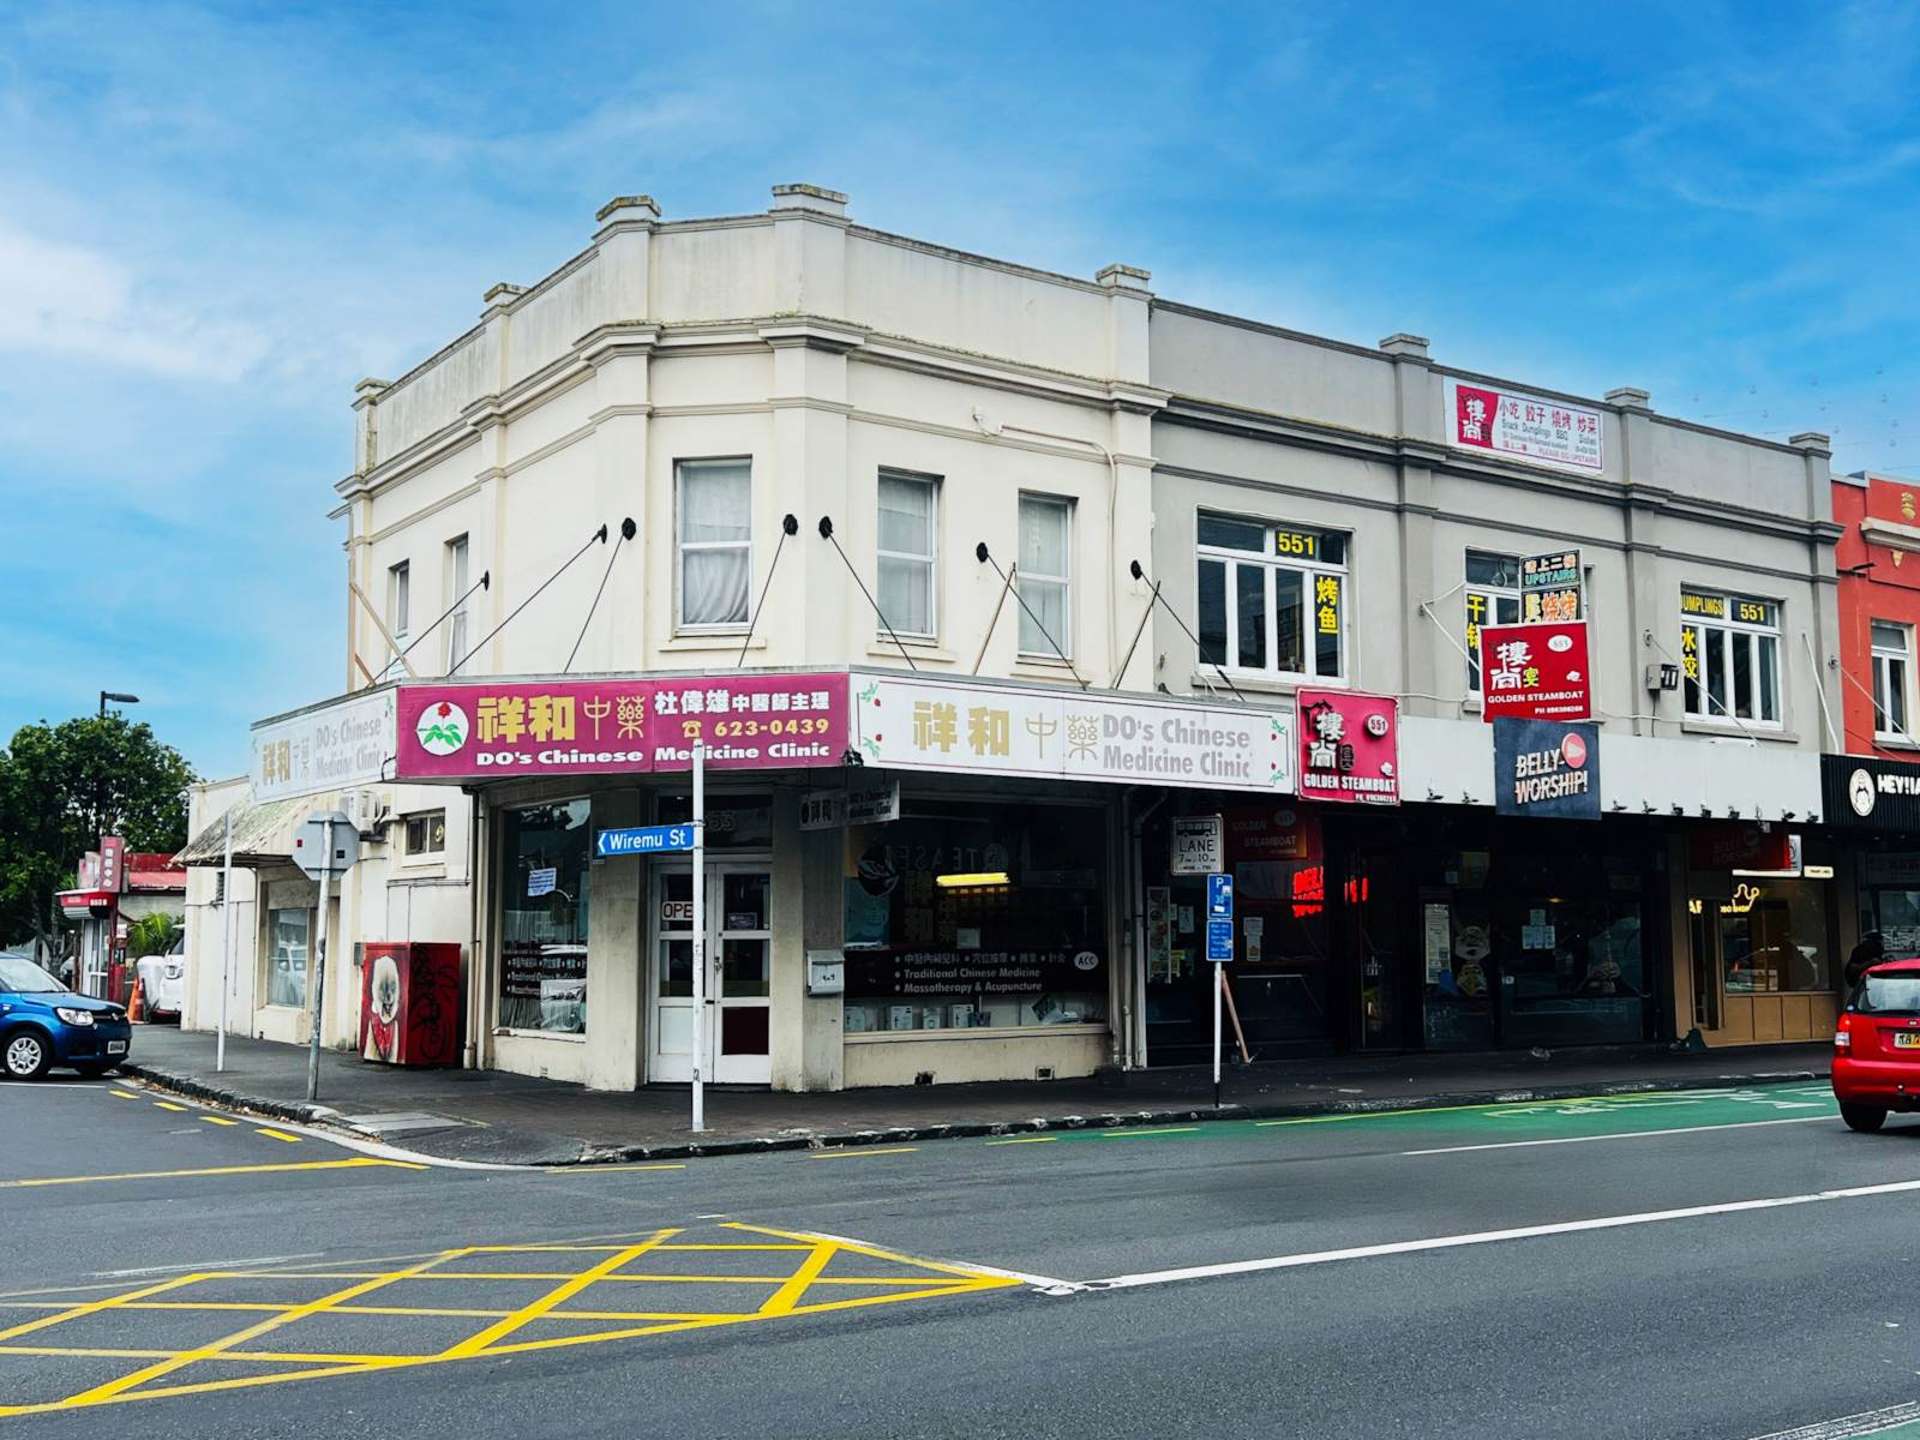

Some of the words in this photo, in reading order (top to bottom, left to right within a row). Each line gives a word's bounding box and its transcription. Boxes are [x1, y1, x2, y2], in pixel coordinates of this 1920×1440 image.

[1278, 533, 1314, 556] 551
[1740, 603, 1764, 621] 551
[1488, 694, 1526, 704] GOLDEN
[1527, 690, 1585, 702] STEAMBOAT
[340, 715, 382, 741] Chinese
[714, 718, 829, 737] 623-0439
[1103, 714, 1155, 741] DO's
[1161, 718, 1250, 748] Chinese
[1370, 718, 1386, 731] 551
[356, 743, 382, 770] Clinic
[477, 751, 533, 766] DO's
[538, 749, 644, 764] Chinese
[655, 744, 760, 761] Meicine
[768, 742, 830, 758] Clinic
[1103, 745, 1194, 774] Medicine
[1200, 751, 1250, 778] Clinic
[1303, 773, 1339, 789] GOLDEN
[1341, 776, 1396, 792] STEAMBOAT
[1515, 770, 1589, 804] WORSHIP!
[610, 833, 663, 851] Wiremu
[669, 829, 686, 846] St
[1179, 839, 1214, 852] LANE
[1216, 877, 1224, 888] P
[664, 903, 694, 918] OPE
[904, 968, 958, 980] Traditional
[960, 967, 997, 979] Chinese
[999, 966, 1041, 978] Medicine
[904, 983, 973, 995] Massotherapy
[985, 980, 1043, 994] Acupuncture
